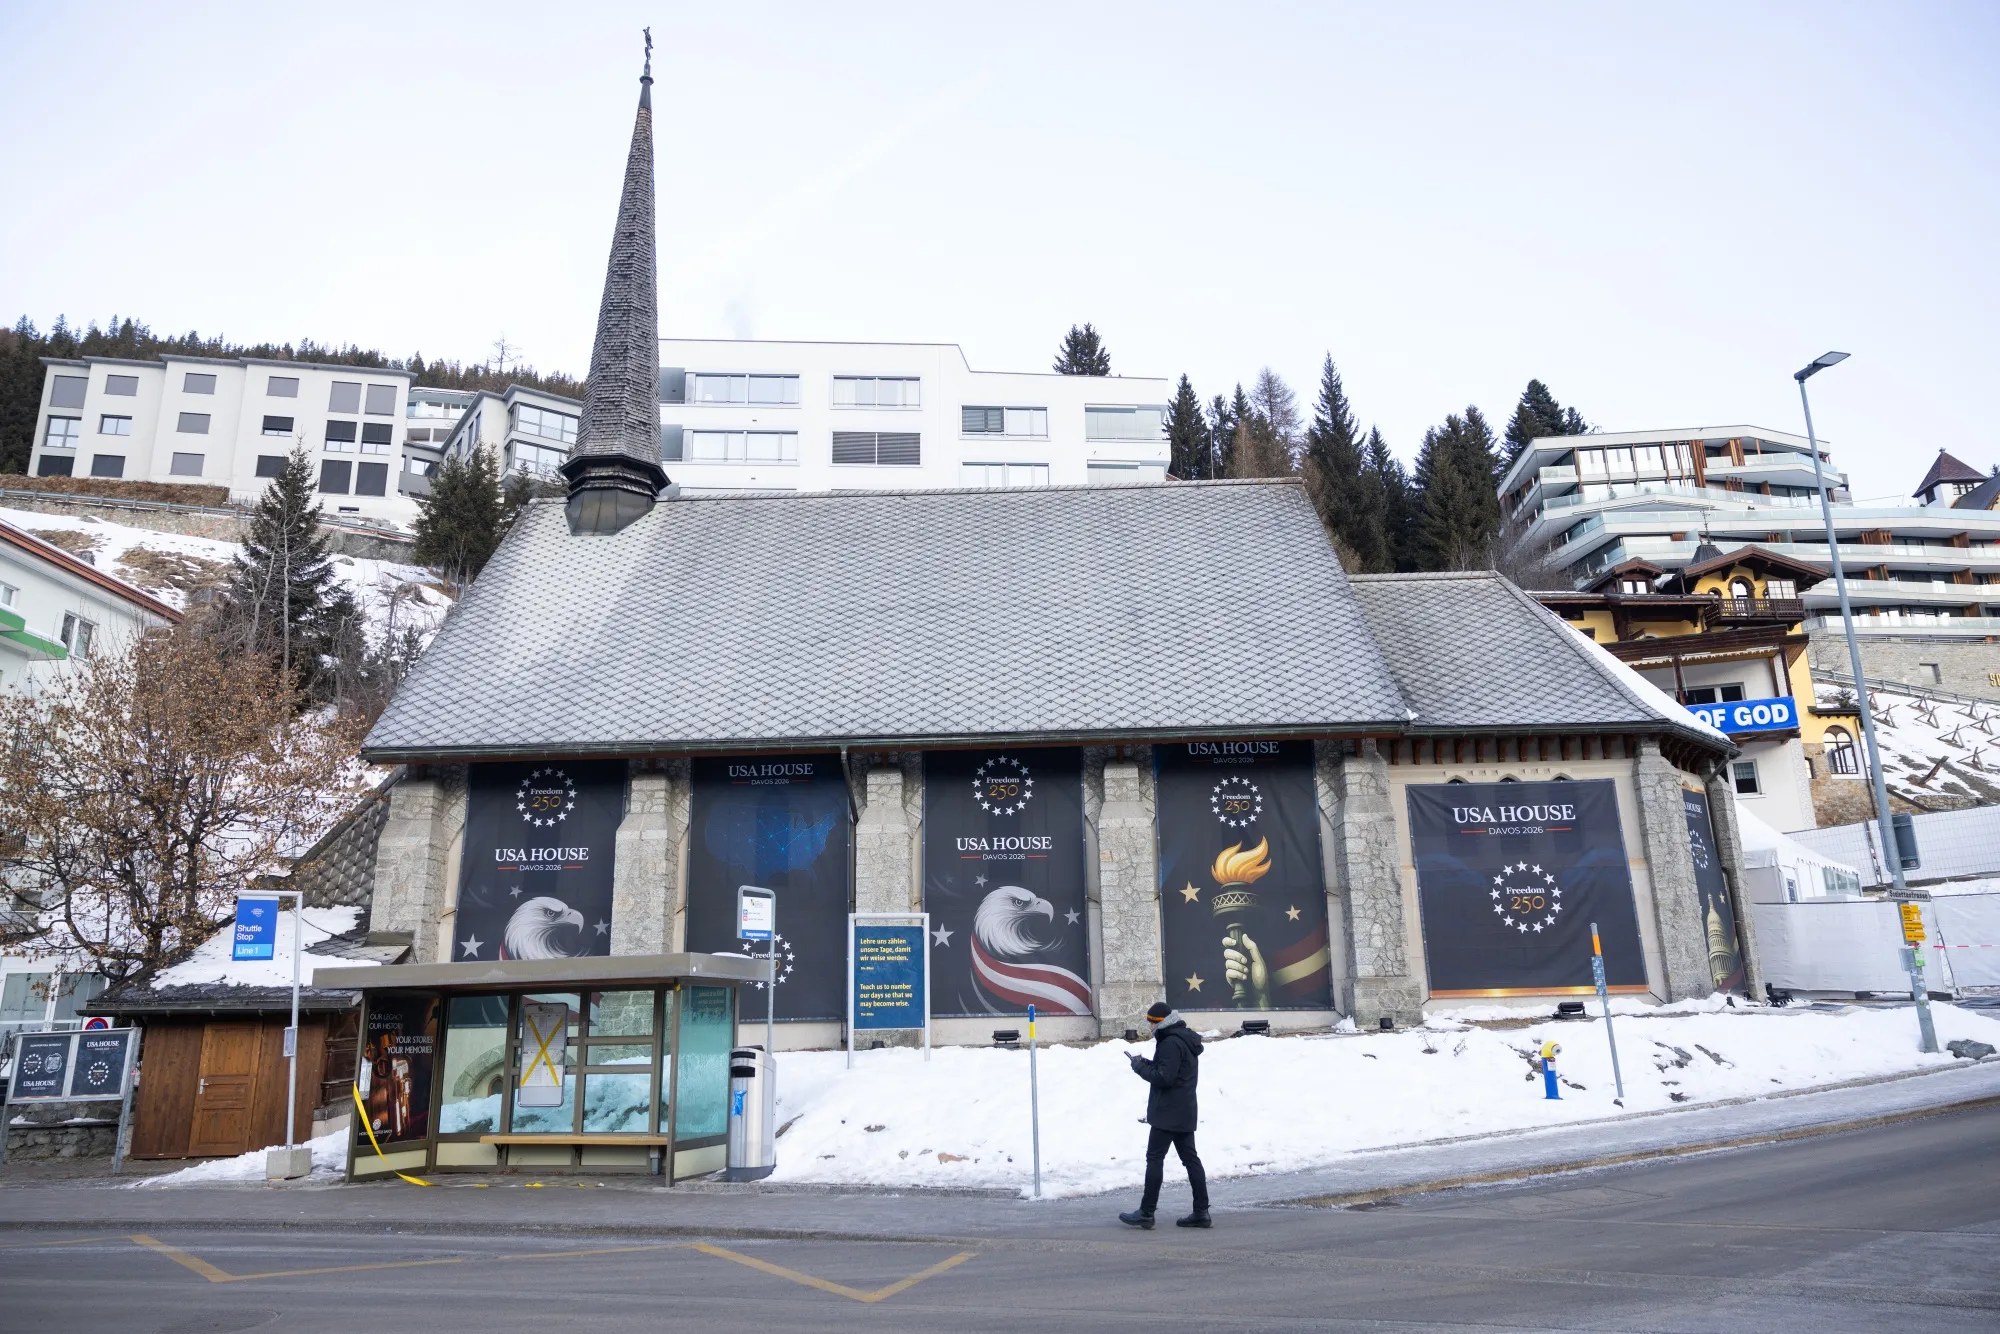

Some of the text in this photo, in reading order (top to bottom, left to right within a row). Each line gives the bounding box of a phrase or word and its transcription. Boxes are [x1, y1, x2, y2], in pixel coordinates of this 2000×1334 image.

[1695, 703, 1790, 728] OF GOD
[1187, 741, 1280, 755] USA HOUSE
[728, 763, 814, 777] USA HOUSE
[988, 784, 1019, 800] 250
[531, 796, 562, 812] 250
[1224, 800, 1250, 814] 250
[1452, 804, 1576, 823] USA HOUSE
[1488, 826, 1544, 835] DAVOS 2026
[956, 836, 1053, 851] USA HOUSE
[495, 847, 589, 862] USA HOUSE
[1506, 886, 1545, 895] Freedom
[1511, 895, 1545, 914] 250
[237, 924, 263, 932] Shuttle
[236, 932, 254, 942] Stop
[237, 946, 259, 955] Line 1
[879, 946, 894, 954] Tage,
[751, 951, 782, 959] Freedm
[870, 992, 884, 1000] days
[368, 1022, 404, 1030] OUR HISTORY
[395, 1035, 434, 1044] YOUR STORIES
[387, 1045, 433, 1054] YOUR MEMORIES
[35, 1079, 56, 1087] HOUSE
